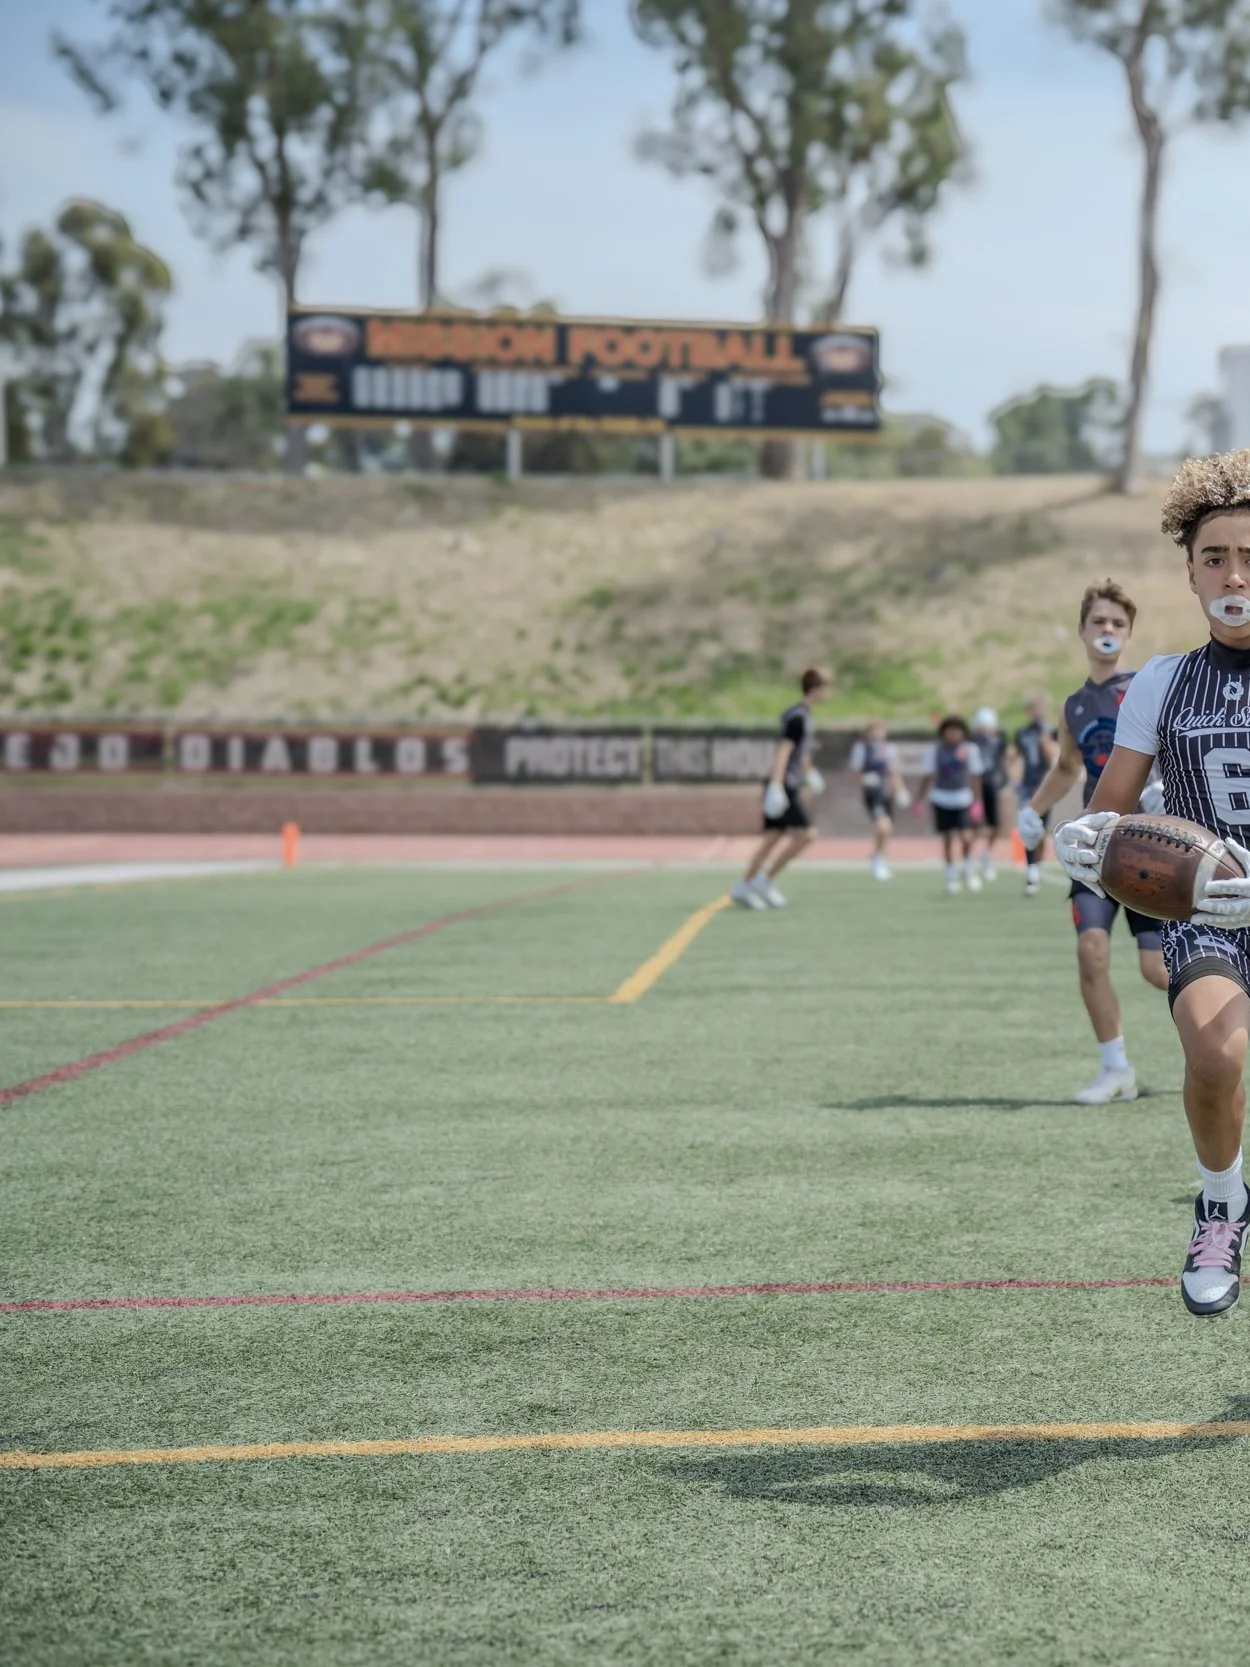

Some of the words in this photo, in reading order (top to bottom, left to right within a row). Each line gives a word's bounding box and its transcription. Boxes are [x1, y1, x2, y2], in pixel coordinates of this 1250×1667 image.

[366, 319, 557, 361] MISSION
[568, 326, 807, 373] FOOTBALL
[1172, 706, 1226, 731] Quick
[181, 735, 470, 774] DIABLOS
[506, 737, 641, 775] PROTECT
[712, 737, 776, 777] HOU
